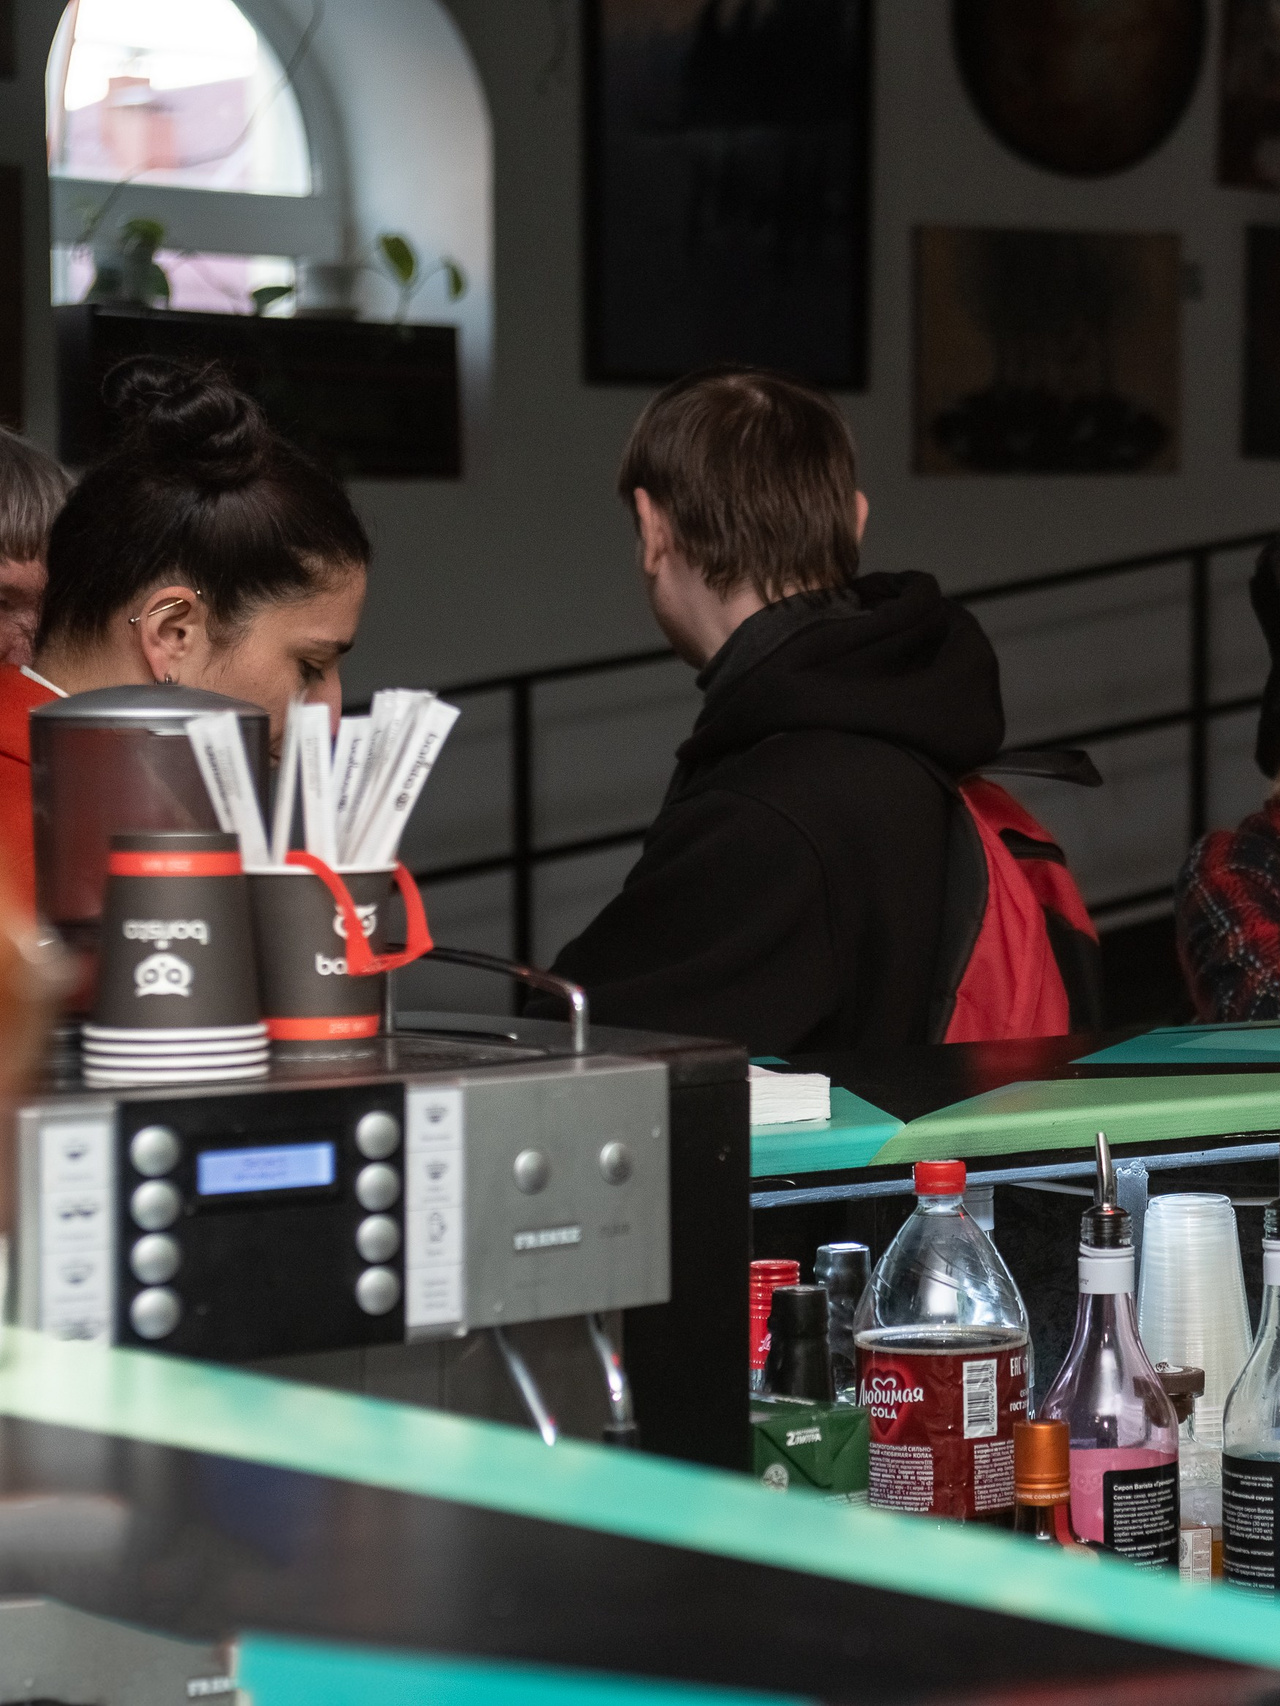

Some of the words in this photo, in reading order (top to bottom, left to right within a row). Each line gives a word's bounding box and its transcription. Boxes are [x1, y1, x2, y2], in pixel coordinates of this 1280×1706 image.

[858, 1377, 924, 1408] Любимая
[871, 1406, 897, 1420] COLA
[786, 1431, 795, 1447] 2
[1113, 1484, 1133, 1492] Сироп
[1134, 1482, 1153, 1490] Barista
